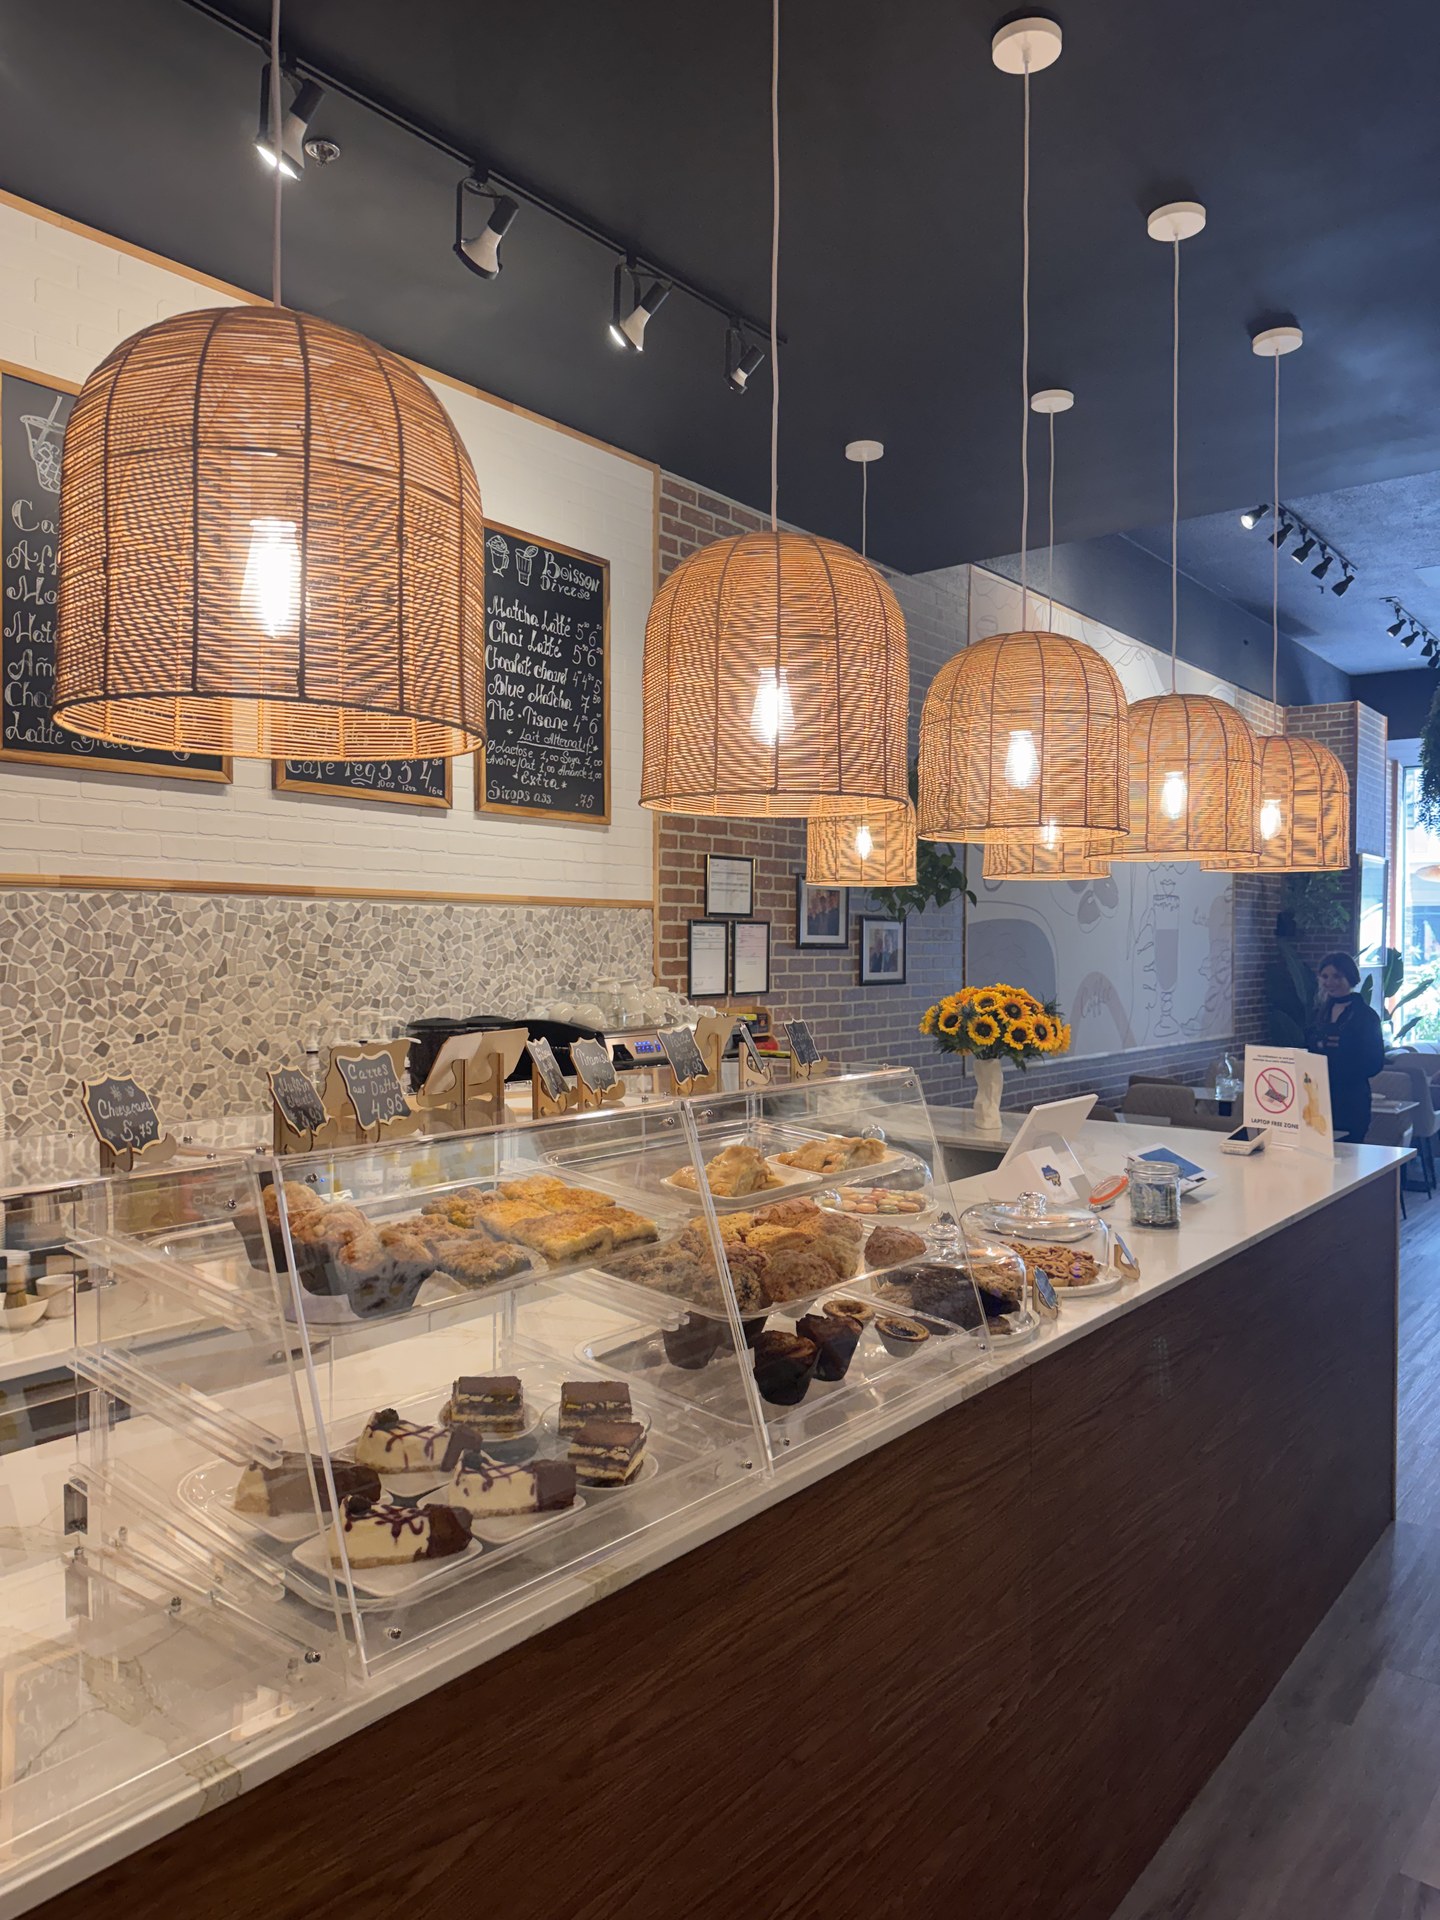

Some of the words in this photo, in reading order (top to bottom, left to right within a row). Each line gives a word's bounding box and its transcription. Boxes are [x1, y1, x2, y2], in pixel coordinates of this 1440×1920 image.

[542, 550, 600, 592] Boisson
[540, 575, 591, 600] Diverse
[487, 595, 539, 626] Matcha
[489, 619, 522, 647] Chai
[488, 674, 525, 698] Blue
[527, 683, 573, 711] Matcha
[487, 699, 514, 721] Thé
[522, 705, 569, 731] Tisane
[495, 740, 534, 758] Lactose
[560, 750, 581, 768] Soya
[519, 728, 540, 742] Lait
[544, 733, 594, 755] Alternatif
[487, 780, 531, 804] Sirops
[520, 770, 560, 790] Extra
[1271, 1120, 1283, 1128] FREE
[1284, 1122, 1299, 1130] ZONE
